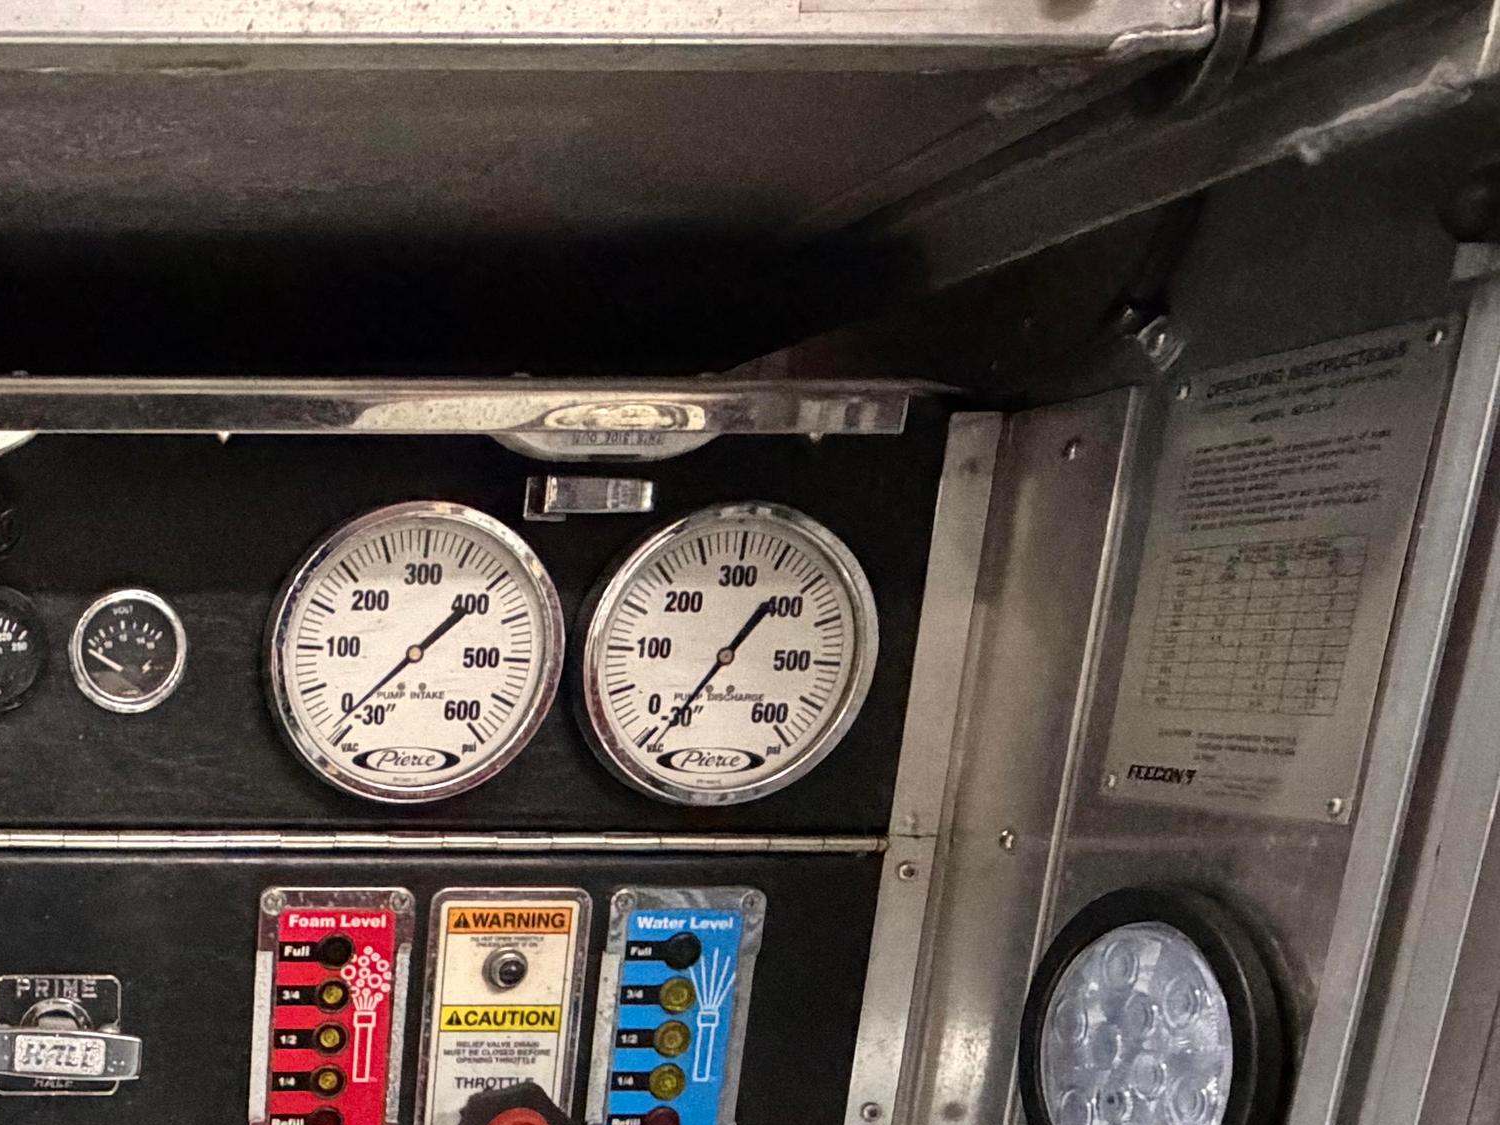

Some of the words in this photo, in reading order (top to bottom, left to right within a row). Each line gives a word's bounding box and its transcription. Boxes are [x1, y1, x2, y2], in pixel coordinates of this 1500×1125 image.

[404, 563, 442, 585] 300
[719, 565, 757, 587] 300
[351, 590, 389, 611] 200
[452, 594, 489, 614] 400
[664, 591, 703, 612] 200
[768, 596, 803, 617] 400
[327, 636, 360, 657] 100
[637, 637, 671, 658] 100
[463, 648, 499, 668] 500
[773, 650, 810, 671] 500
[341, 692, 353, 713] 0
[376, 691, 405, 700] PUMP
[410, 691, 445, 700] INTAKE
[707, 693, 764, 701] DISCHARGE
[444, 700, 480, 720] 600
[648, 694, 661, 714] 0
[752, 703, 788, 723] 600
[341, 743, 359, 752] VAC
[462, 742, 477, 755] psi
[766, 744, 781, 756] psi
[376, 750, 436, 768] Pierce
[680, 752, 741, 768] Pierce
[289, 914, 336, 928] Foam
[340, 914, 387, 928] Level
[471, 913, 566, 928] WARNING
[636, 916, 686, 929] Water
[690, 916, 734, 929] Level
[284, 946, 310, 956] Full
[630, 946, 652, 956] Full
[16, 978, 98, 998] PRIME
[282, 990, 299, 999] 3/4
[626, 990, 643, 999] 3/4
[464, 1010, 556, 1026] CAUTION
[280, 1035, 297, 1045] 1/2
[621, 1035, 637, 1044] 1/2
[278, 1078, 295, 1087] 1/4
[617, 1076, 634, 1086] 1/4
